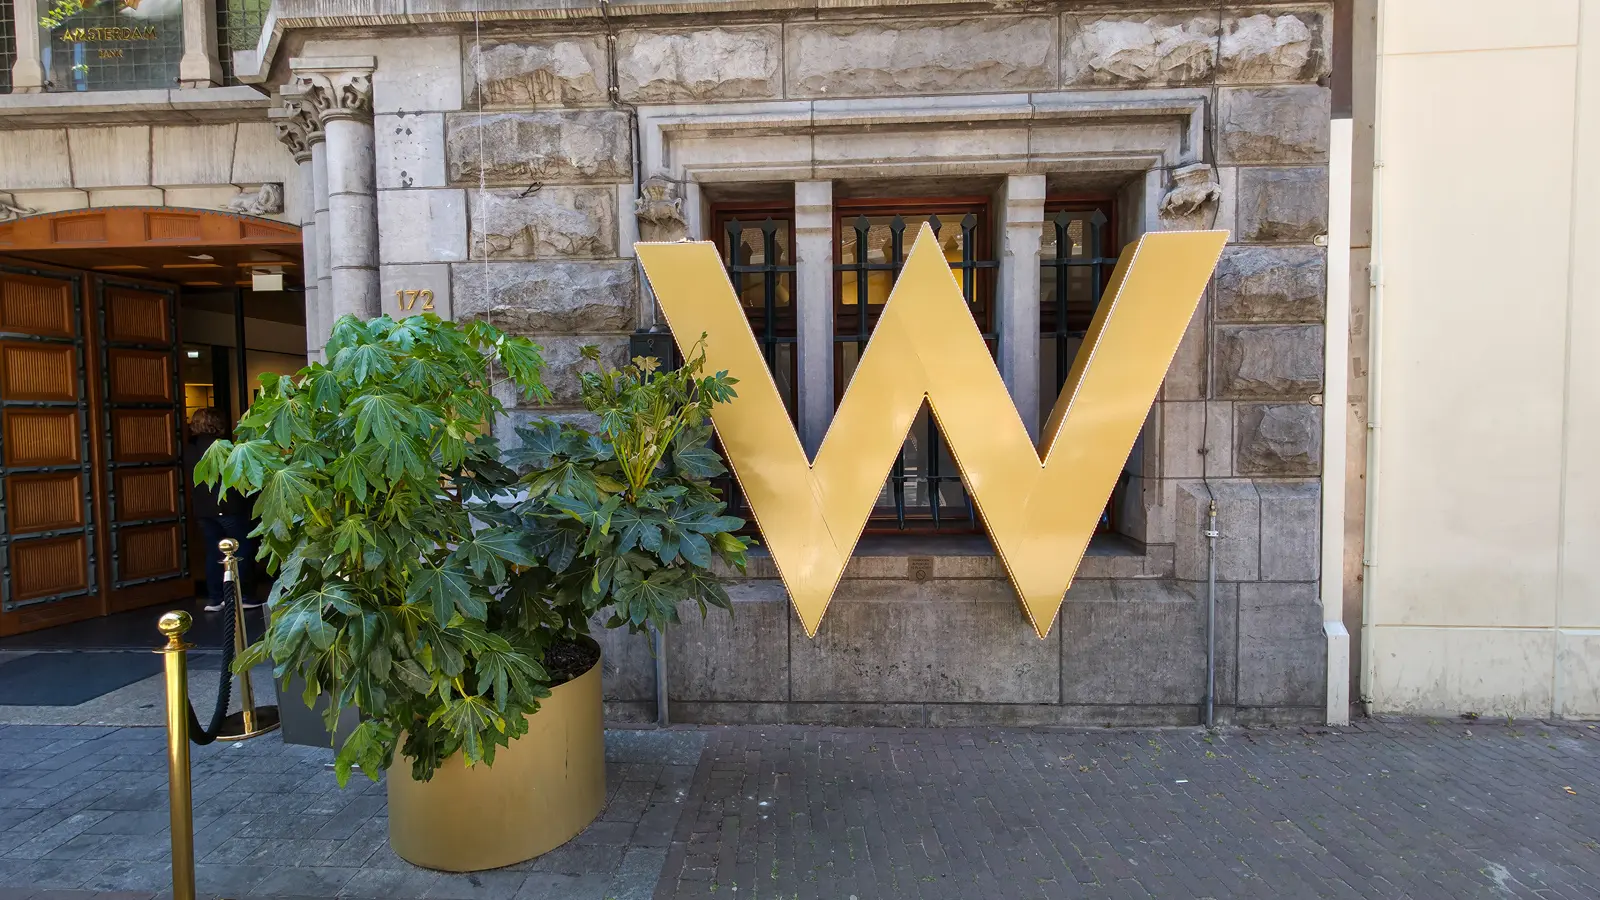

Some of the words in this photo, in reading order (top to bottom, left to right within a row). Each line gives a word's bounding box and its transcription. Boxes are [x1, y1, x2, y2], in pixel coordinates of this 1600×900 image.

[61, 26, 157, 42] AMSTERDAM
[396, 289, 435, 311] 172
[634, 221, 1230, 638] W
